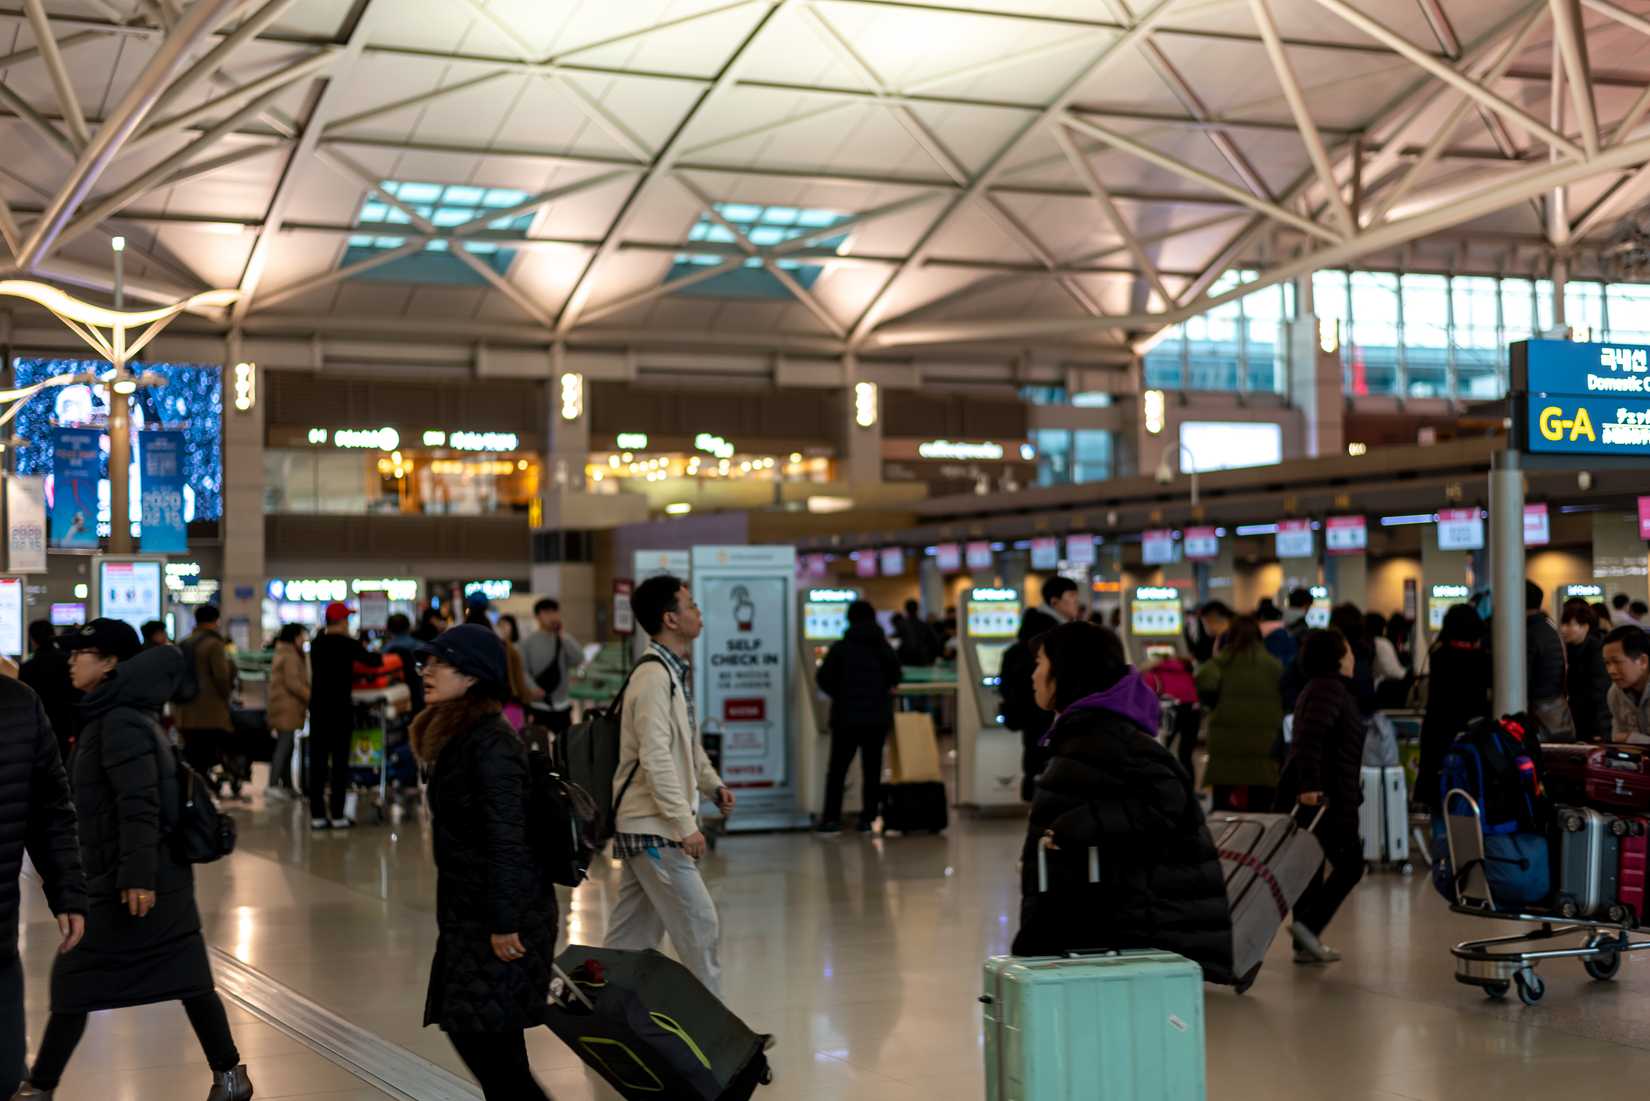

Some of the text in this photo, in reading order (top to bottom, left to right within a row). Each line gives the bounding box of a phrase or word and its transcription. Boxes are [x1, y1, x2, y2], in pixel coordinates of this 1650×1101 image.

[1601, 347, 1648, 372] 국내선
[1587, 373, 1643, 392] Domestic
[1539, 406, 1596, 442] G-A
[727, 639, 762, 651] SELF
[711, 653, 779, 666] CHECK IN
